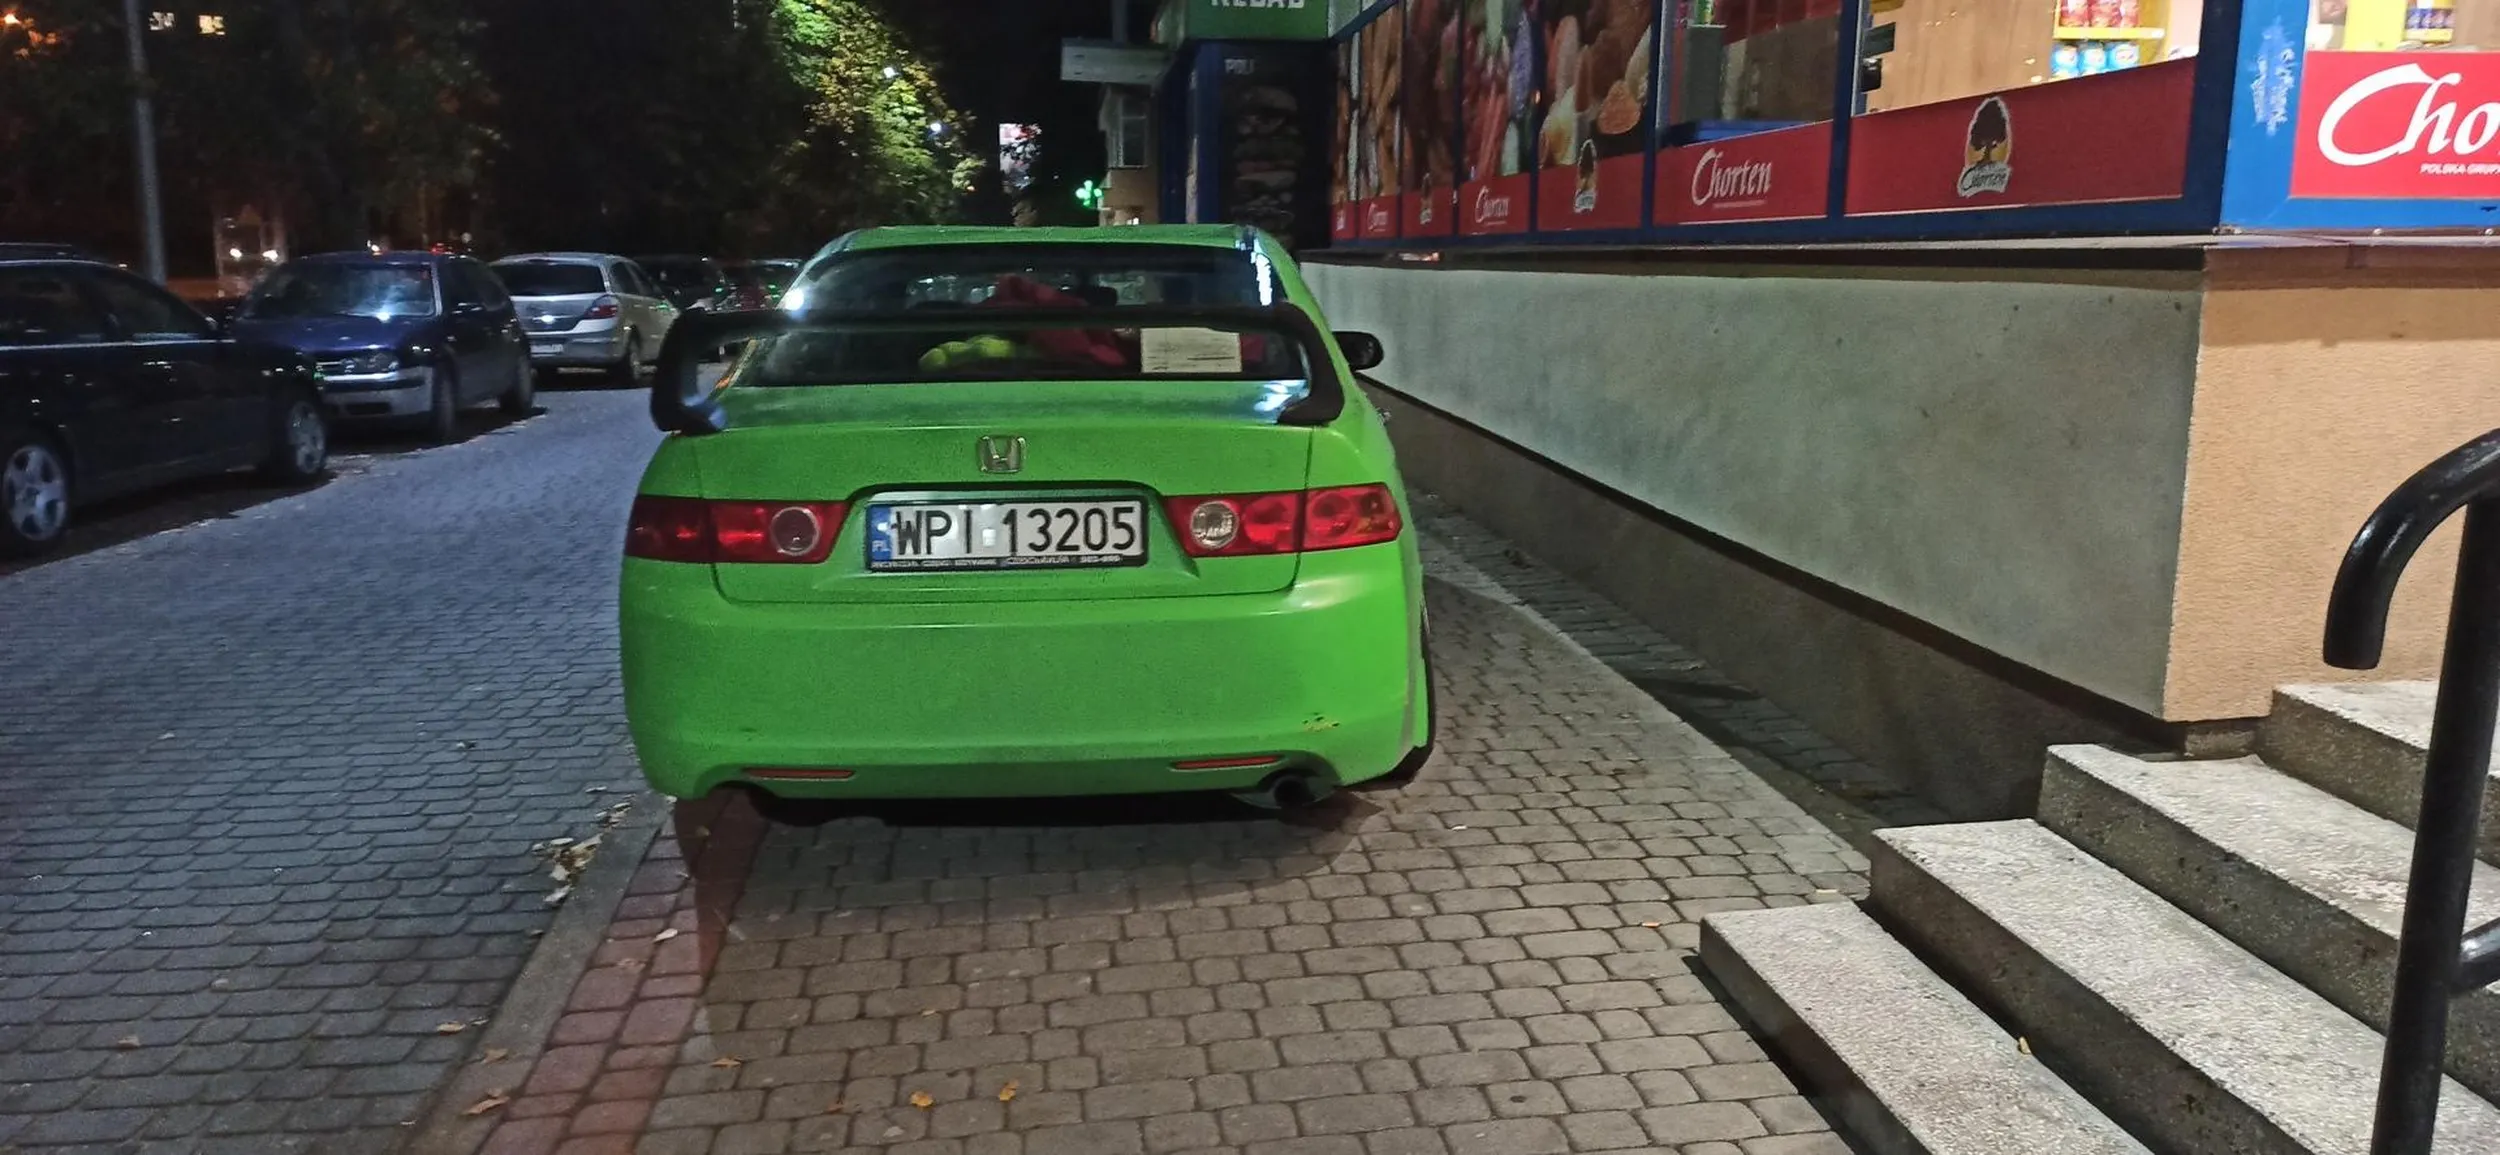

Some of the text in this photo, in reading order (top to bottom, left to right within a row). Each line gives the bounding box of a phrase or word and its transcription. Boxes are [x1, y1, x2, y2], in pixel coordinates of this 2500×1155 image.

[2318, 63, 2500, 166] Cho
[1692, 148, 1771, 206] Chorten
[896, 506, 1136, 556] WPI 13205
